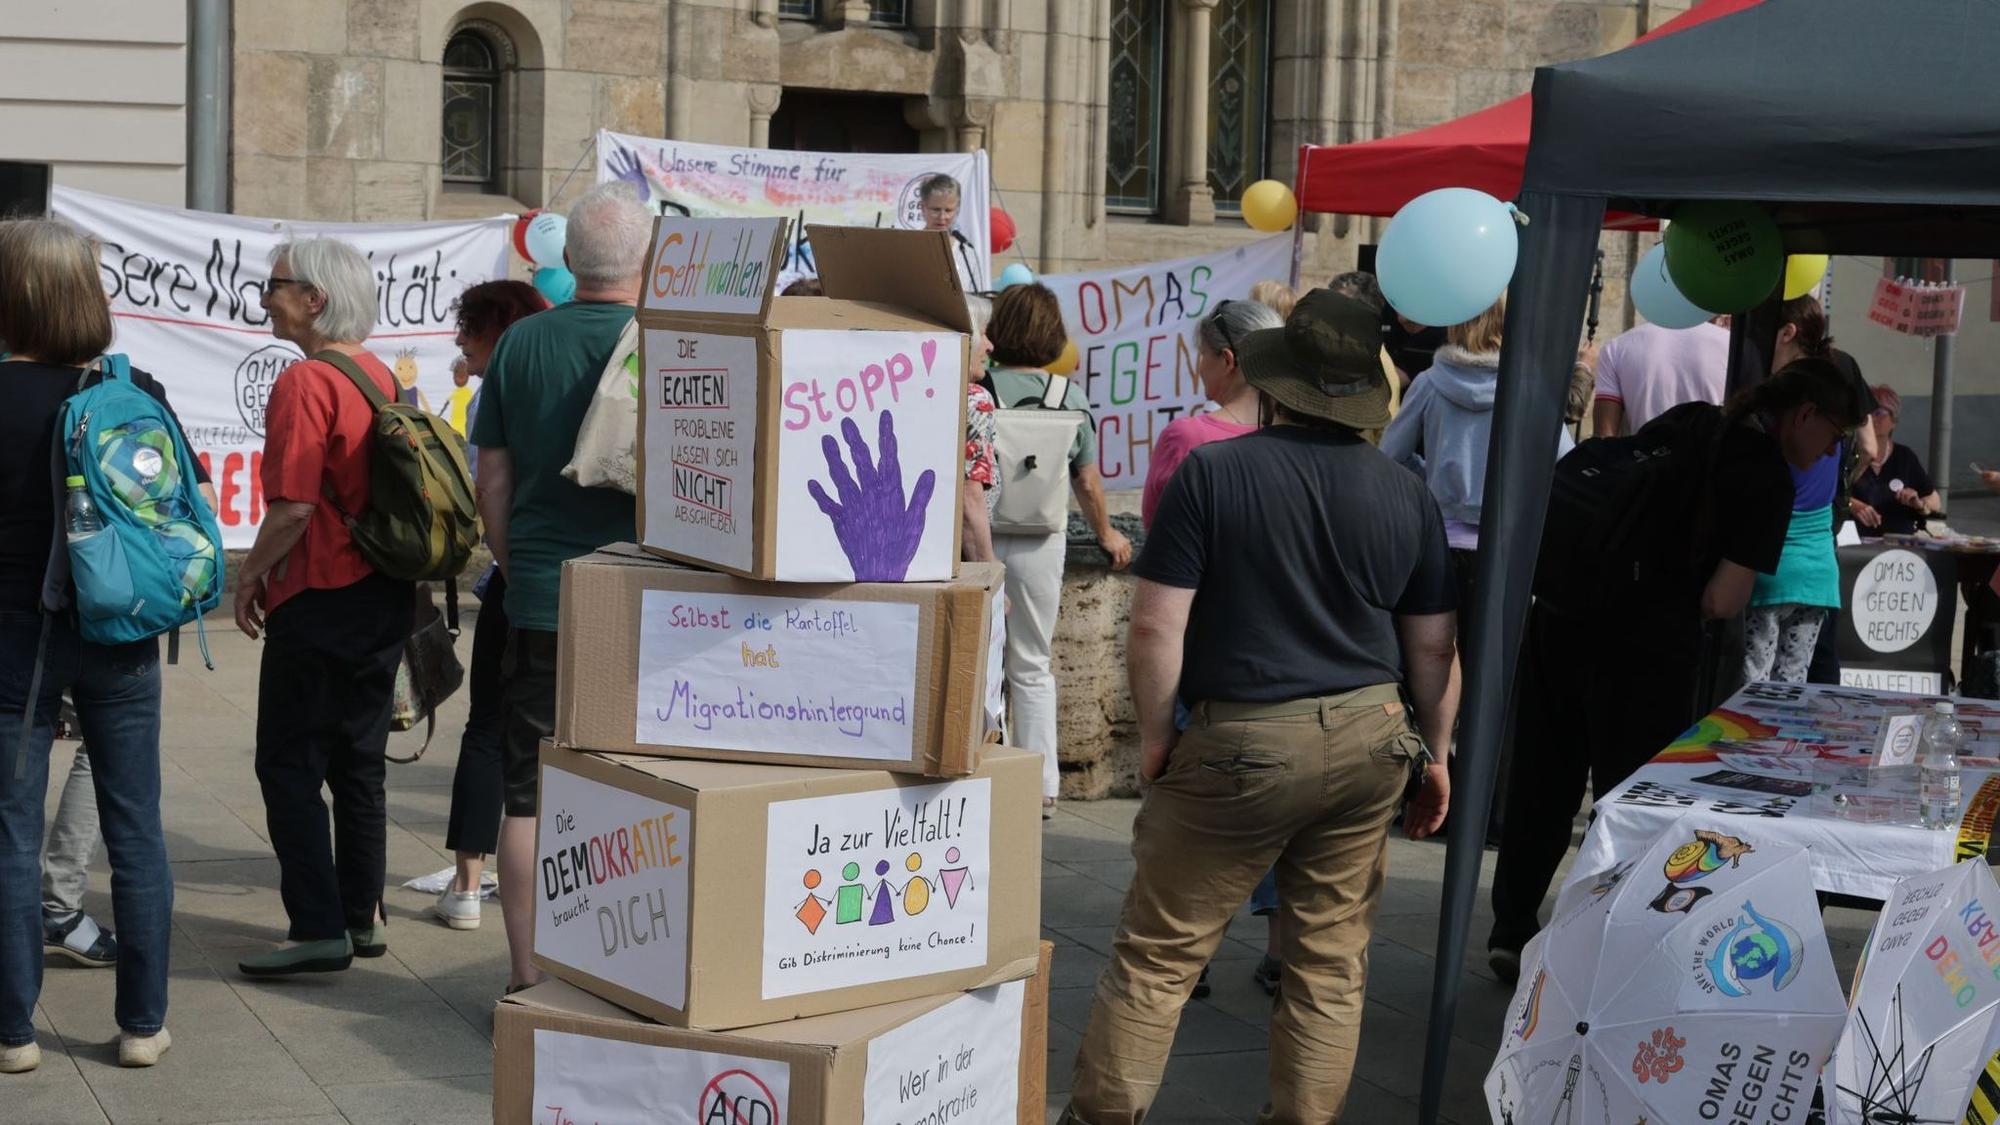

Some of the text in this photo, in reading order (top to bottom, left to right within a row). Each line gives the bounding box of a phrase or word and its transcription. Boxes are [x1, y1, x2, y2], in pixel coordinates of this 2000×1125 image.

[658, 147, 848, 182] Unsere Stimme für
[100, 242, 197, 312] sere
[655, 231, 712, 299] Geht
[1078, 266, 1212, 335] OMAS
[677, 338, 699, 360] DIE
[783, 338, 938, 432] Stopp!
[1075, 332, 1202, 406] EGEN
[663, 375, 725, 406] ECHTEN
[674, 418, 735, 440] PROBLEME
[670, 445, 739, 467] LASSEN SICH
[674, 470, 728, 510] NICHT
[674, 504, 737, 536] ABSCHIEBEN
[1873, 562, 1915, 583] OMAS
[1866, 591, 1925, 612] GEGEN
[668, 604, 858, 640] Selbst die Kartoffel
[1867, 621, 1920, 642] RECHTS
[741, 641, 781, 669] hat
[656, 679, 906, 738] Migrationshintergrund
[556, 808, 576, 835] Die
[807, 796, 967, 856] Ja zur Vielfalt!
[542, 812, 683, 902] DEMOKRATIE
[552, 892, 591, 928] braucht
[597, 887, 671, 958] DICH
[778, 957, 798, 970] Gib
[803, 943, 890, 968] Diskriminierung
[899, 937, 922, 953] keine
[1692, 918, 1734, 994] SAVE THE WORLD
[899, 1043, 975, 1103] Wer in der
[1699, 1041, 1742, 1120] OMAS
